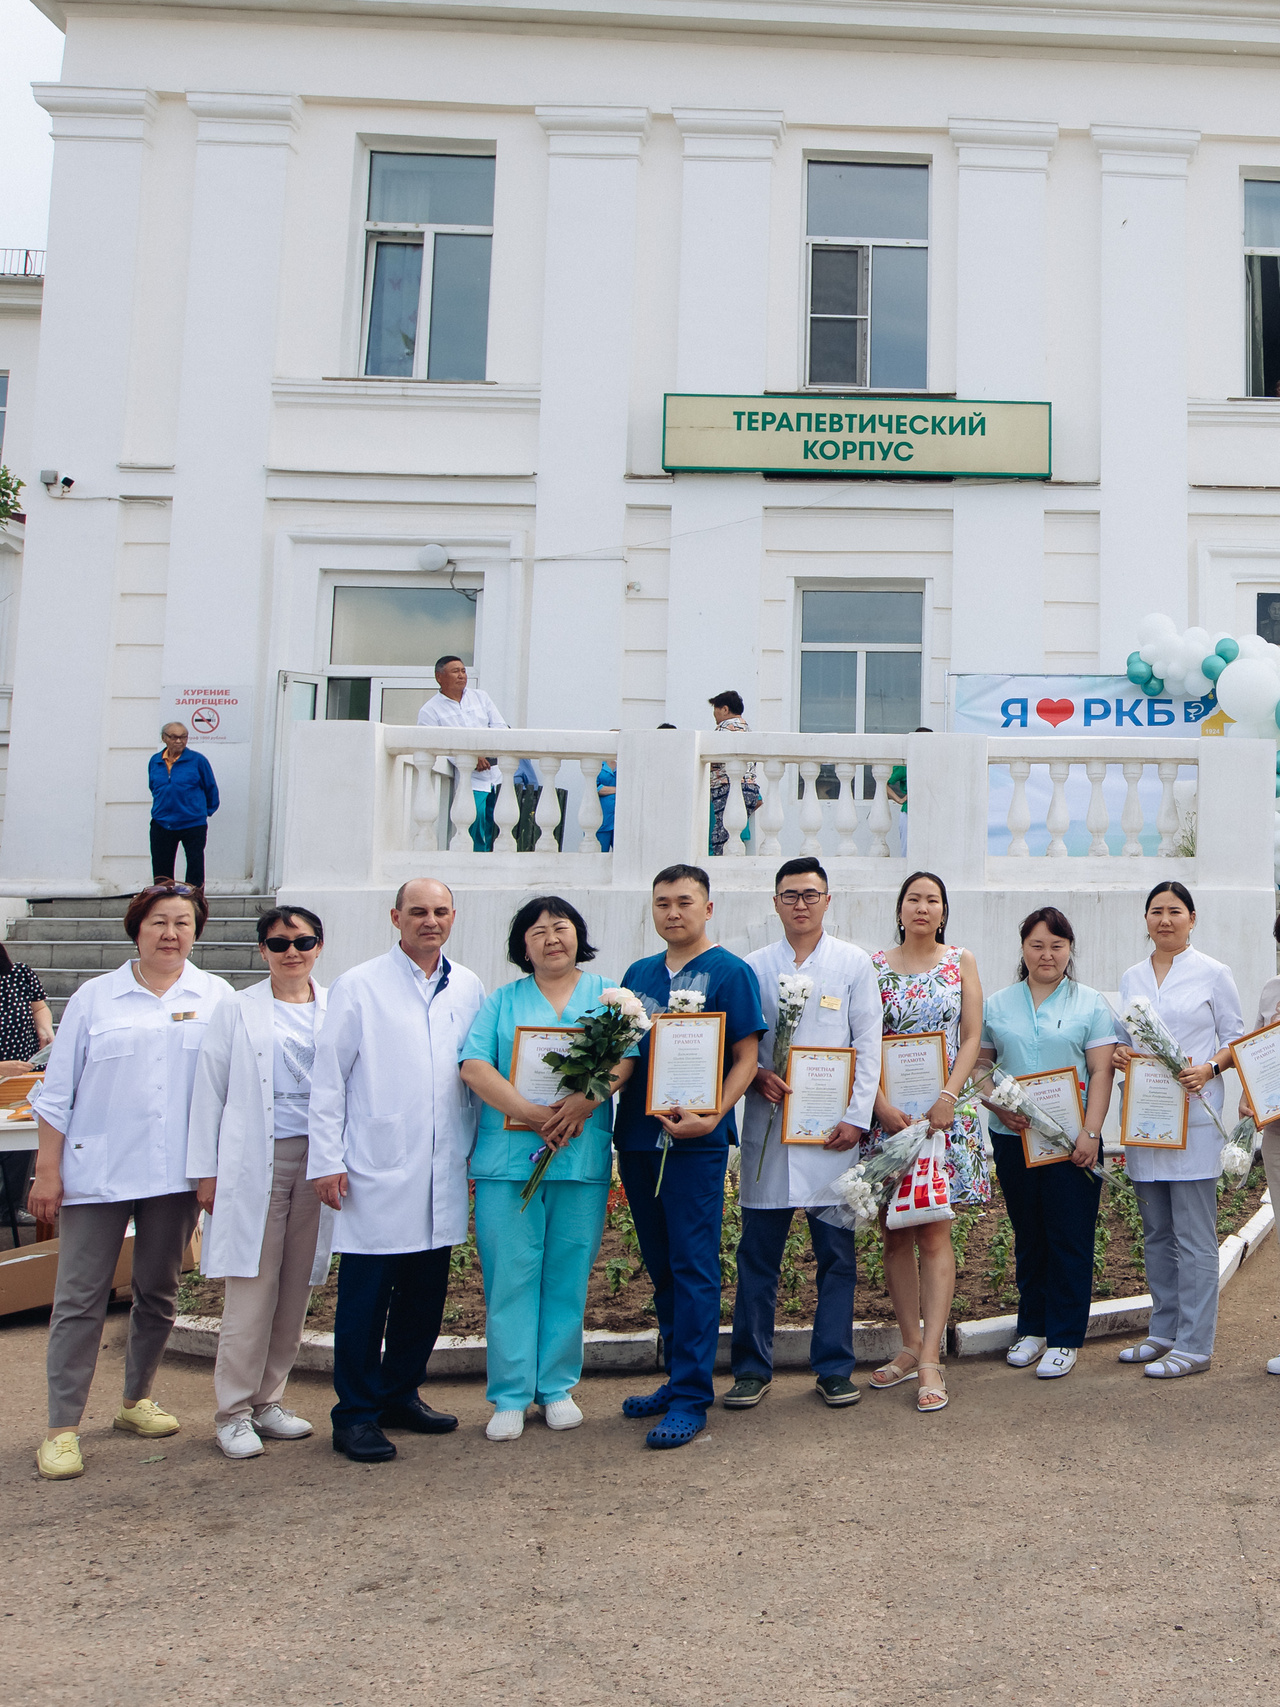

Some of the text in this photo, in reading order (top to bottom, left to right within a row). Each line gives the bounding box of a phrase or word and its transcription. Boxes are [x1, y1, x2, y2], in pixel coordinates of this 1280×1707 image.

[732, 410, 987, 437] ТЕРАПЕВТИЧЕСКИЙ
[802, 439, 914, 462] КОРПУС
[175, 698, 239, 706] ЗАПРЕЩЕНО
[1000, 697, 1176, 729] Я РКБ
